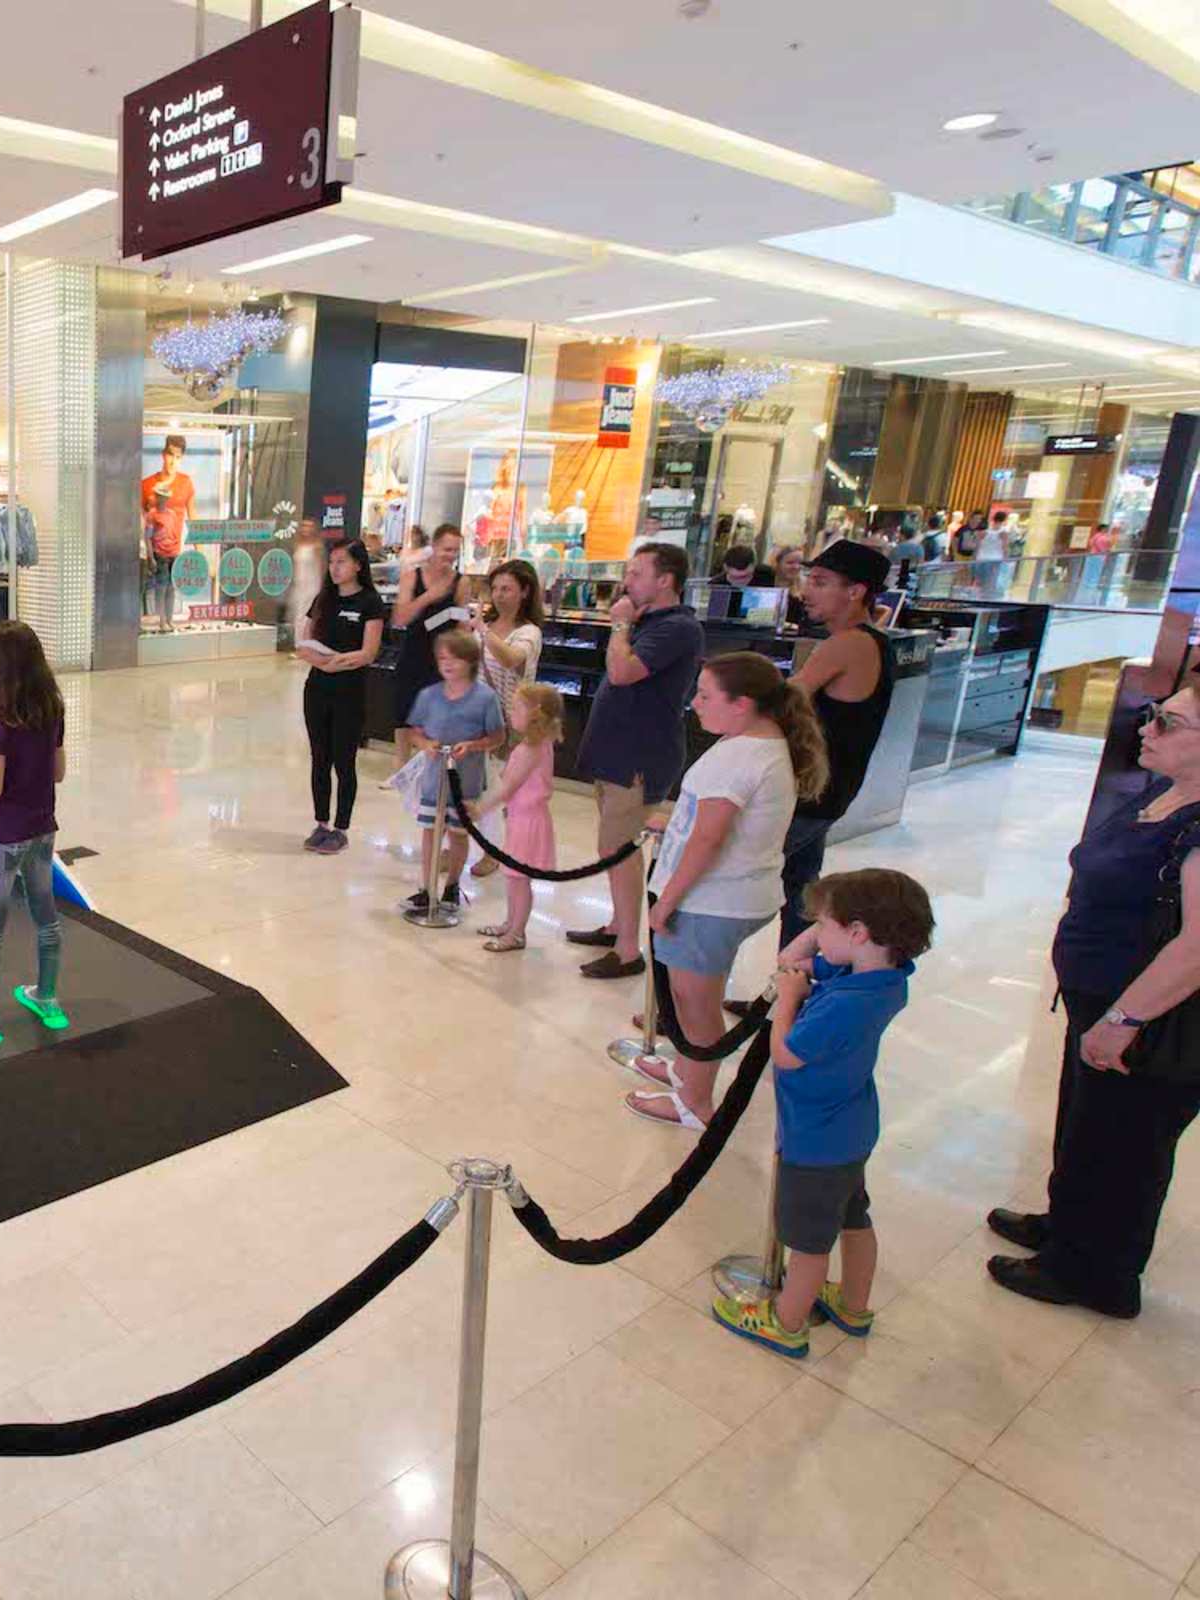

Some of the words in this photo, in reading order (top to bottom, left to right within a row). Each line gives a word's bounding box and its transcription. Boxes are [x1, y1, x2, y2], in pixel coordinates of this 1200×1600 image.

[164, 93, 193, 122] David
[194, 84, 224, 114] Jones
[162, 116, 201, 147] Oxford
[202, 105, 236, 132] Street
[164, 150, 189, 171] Valet
[190, 136, 230, 162] Parking
[300, 127, 321, 189] 3
[162, 168, 217, 197] Restrooms
[192, 602, 251, 618] EXTENDED
